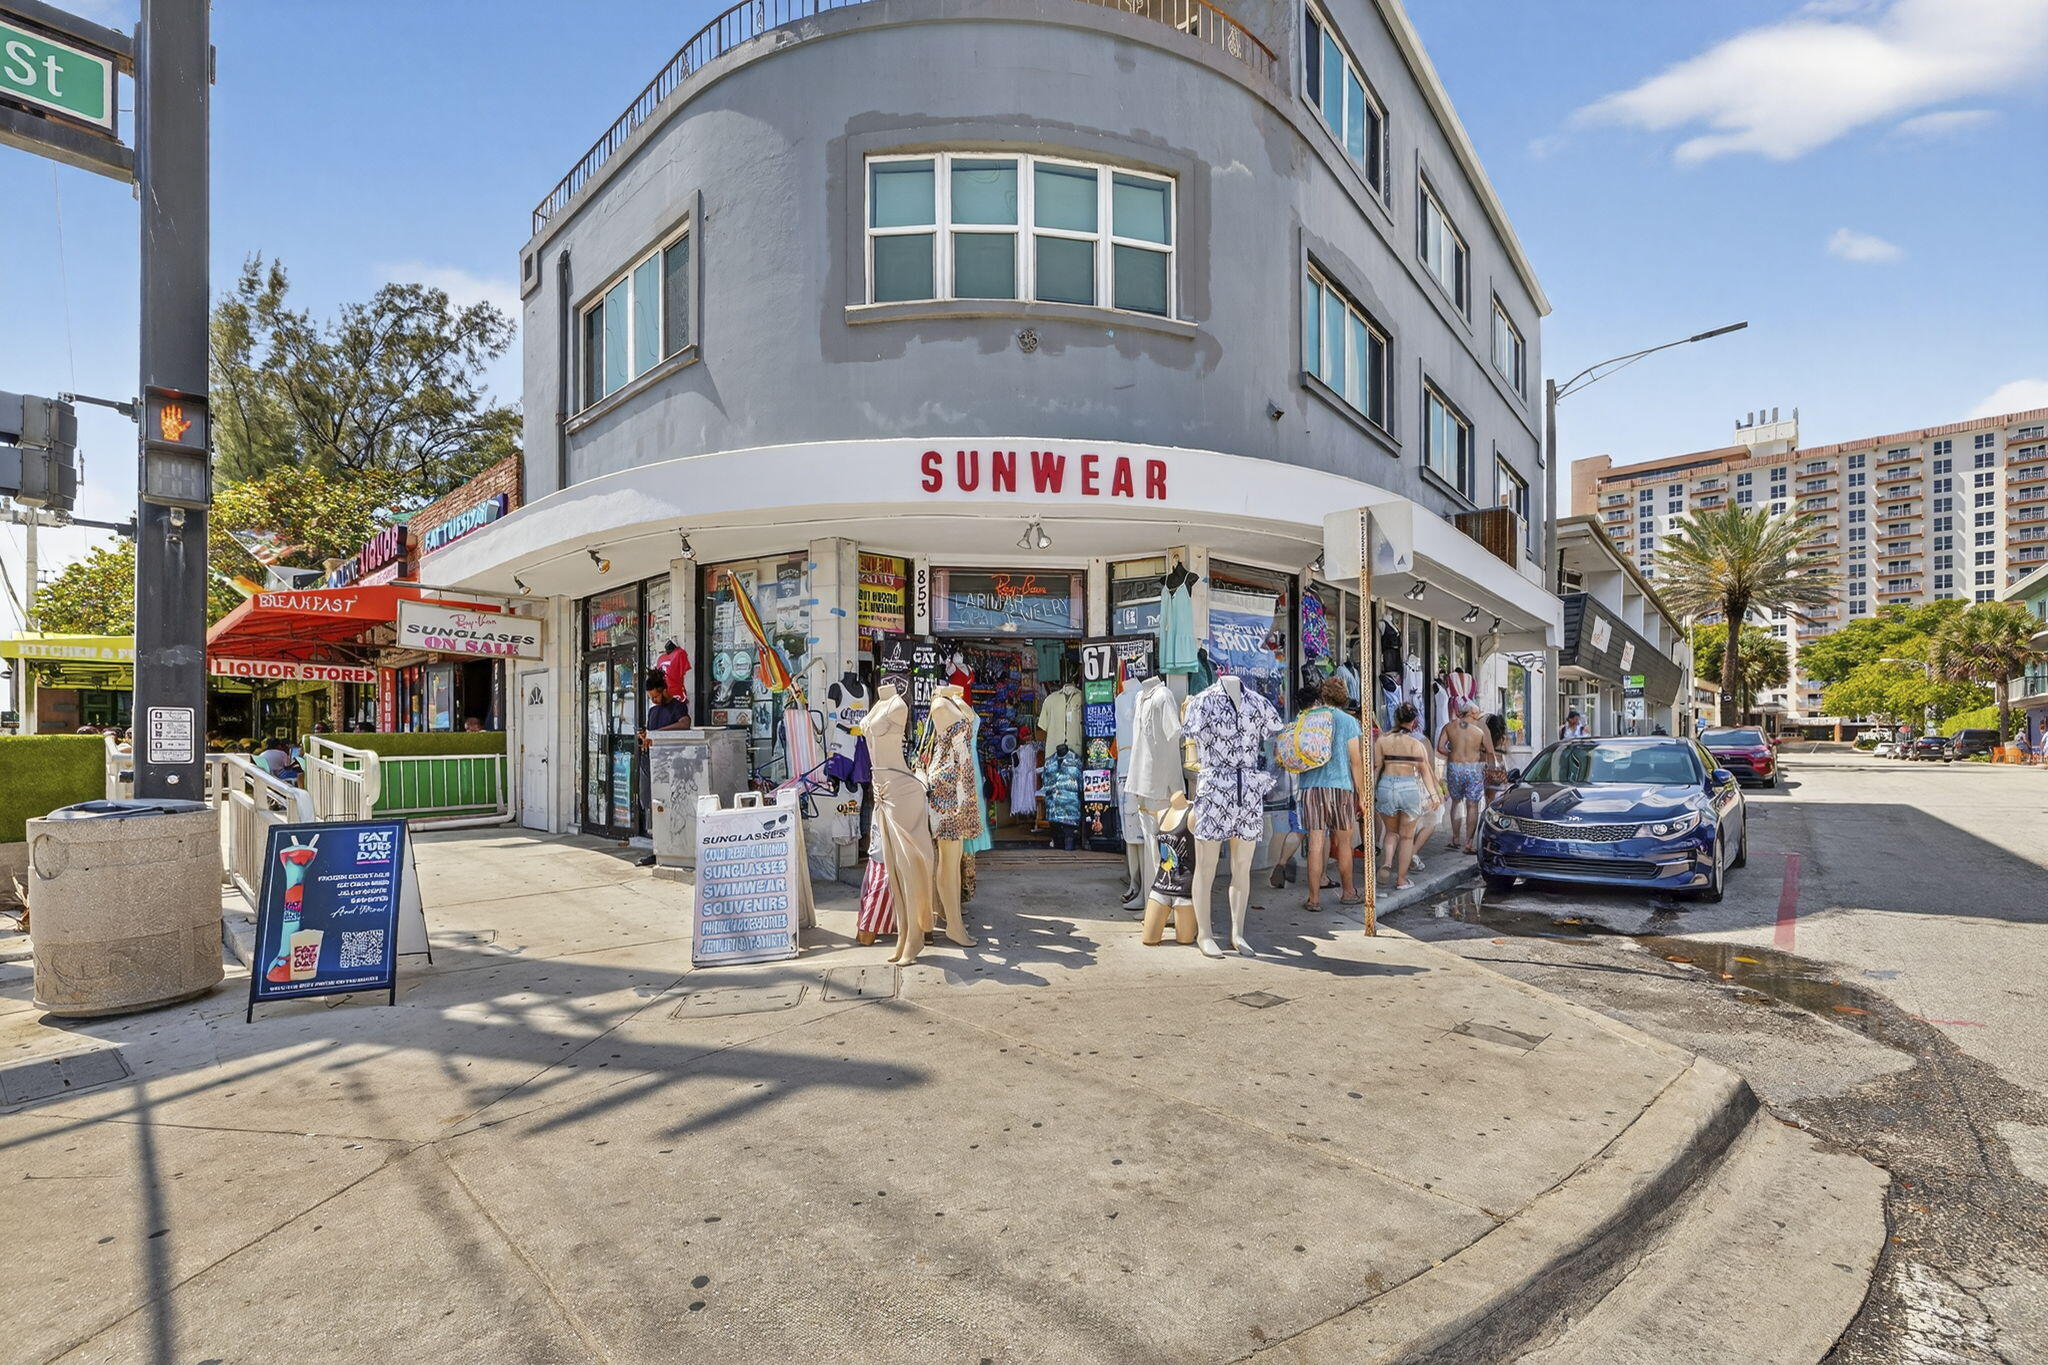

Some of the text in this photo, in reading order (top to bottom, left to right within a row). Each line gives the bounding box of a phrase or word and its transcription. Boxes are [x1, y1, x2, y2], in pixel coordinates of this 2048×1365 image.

[4, 40, 64, 97] St
[921, 450, 1167, 500] SUNWEAR
[258, 593, 358, 613] BREAKFAST
[406, 623, 535, 645] SUNGLASES
[424, 636, 520, 656] ON SALE
[216, 660, 365, 683] LIQUOR STORE
[358, 831, 393, 843] FAT
[702, 830, 787, 845] SUNGLASSES
[356, 850, 391, 861] DAY
[703, 877, 787, 899] SWIMWEAR
[702, 895, 788, 917] SOUVENIRS
